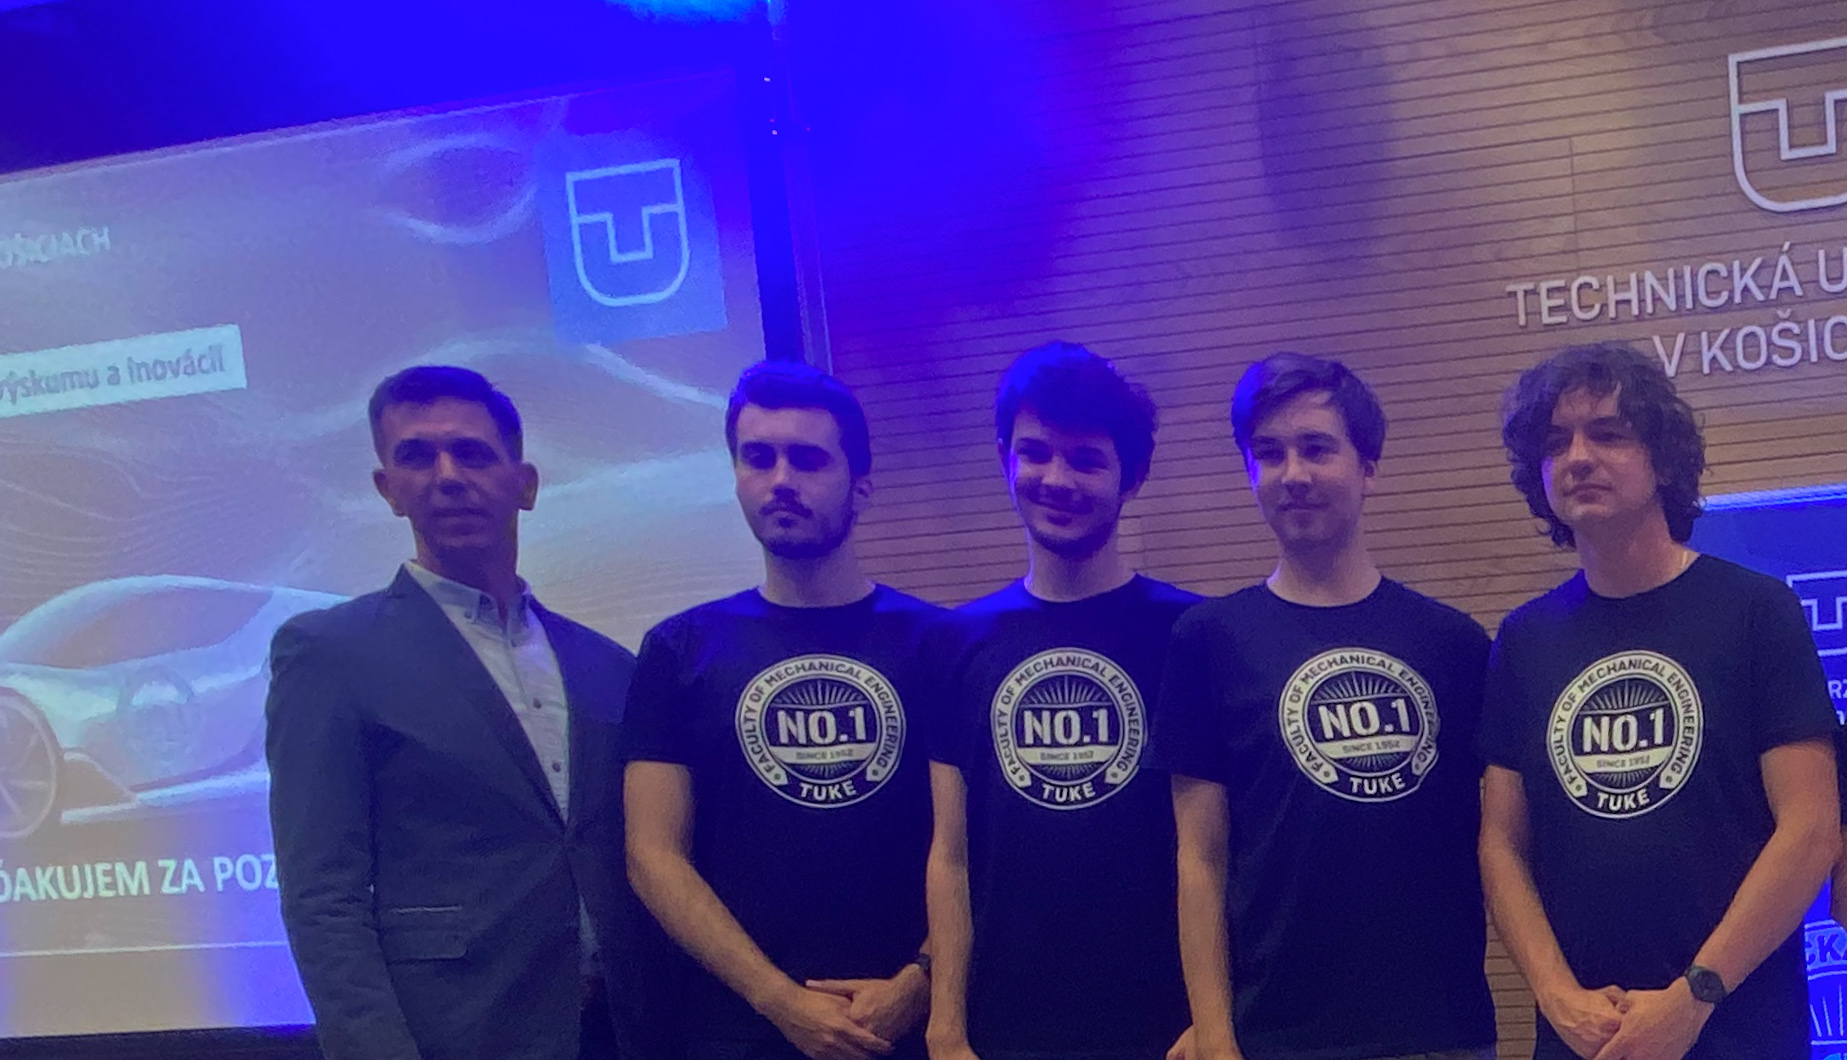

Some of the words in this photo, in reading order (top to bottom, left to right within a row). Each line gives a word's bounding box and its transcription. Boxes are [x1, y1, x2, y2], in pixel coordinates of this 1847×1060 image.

[1507, 242, 1803, 326] TECHNICKÁ
[1653, 331, 1686, 378] V
[107, 362, 121, 386] a
[764, 661, 862, 687] MECHANICAL
[1015, 656, 1106, 685] MECHANICAL
[1301, 655, 1394, 684] MECHANICAL
[1577, 659, 1666, 692] MECHANICAL
[751, 686, 765, 701] OF
[1002, 687, 1016, 705] OF
[1290, 685, 1303, 703] OF
[1562, 692, 1576, 712] OF
[777, 706, 866, 744] NO.1
[864, 676, 898, 768] ENGINEERING
[1023, 709, 1108, 744] NO.1
[1109, 675, 1140, 771] ENGINEERING
[1318, 698, 1410, 739] NO.1
[1583, 708, 1664, 752] NO.1
[1667, 673, 1695, 775] ENGINEERING
[744, 706, 775, 773] FACULTY
[997, 709, 1020, 775] FACULTY
[1287, 708, 1323, 772] FACULTY
[1554, 716, 1577, 785] FACULTY
[799, 780, 856, 800] TUKE
[1042, 782, 1095, 802] TUKE
[1350, 773, 1405, 794] TUKE
[1597, 789, 1650, 811] TUKE
[158, 858, 206, 894] ZA
